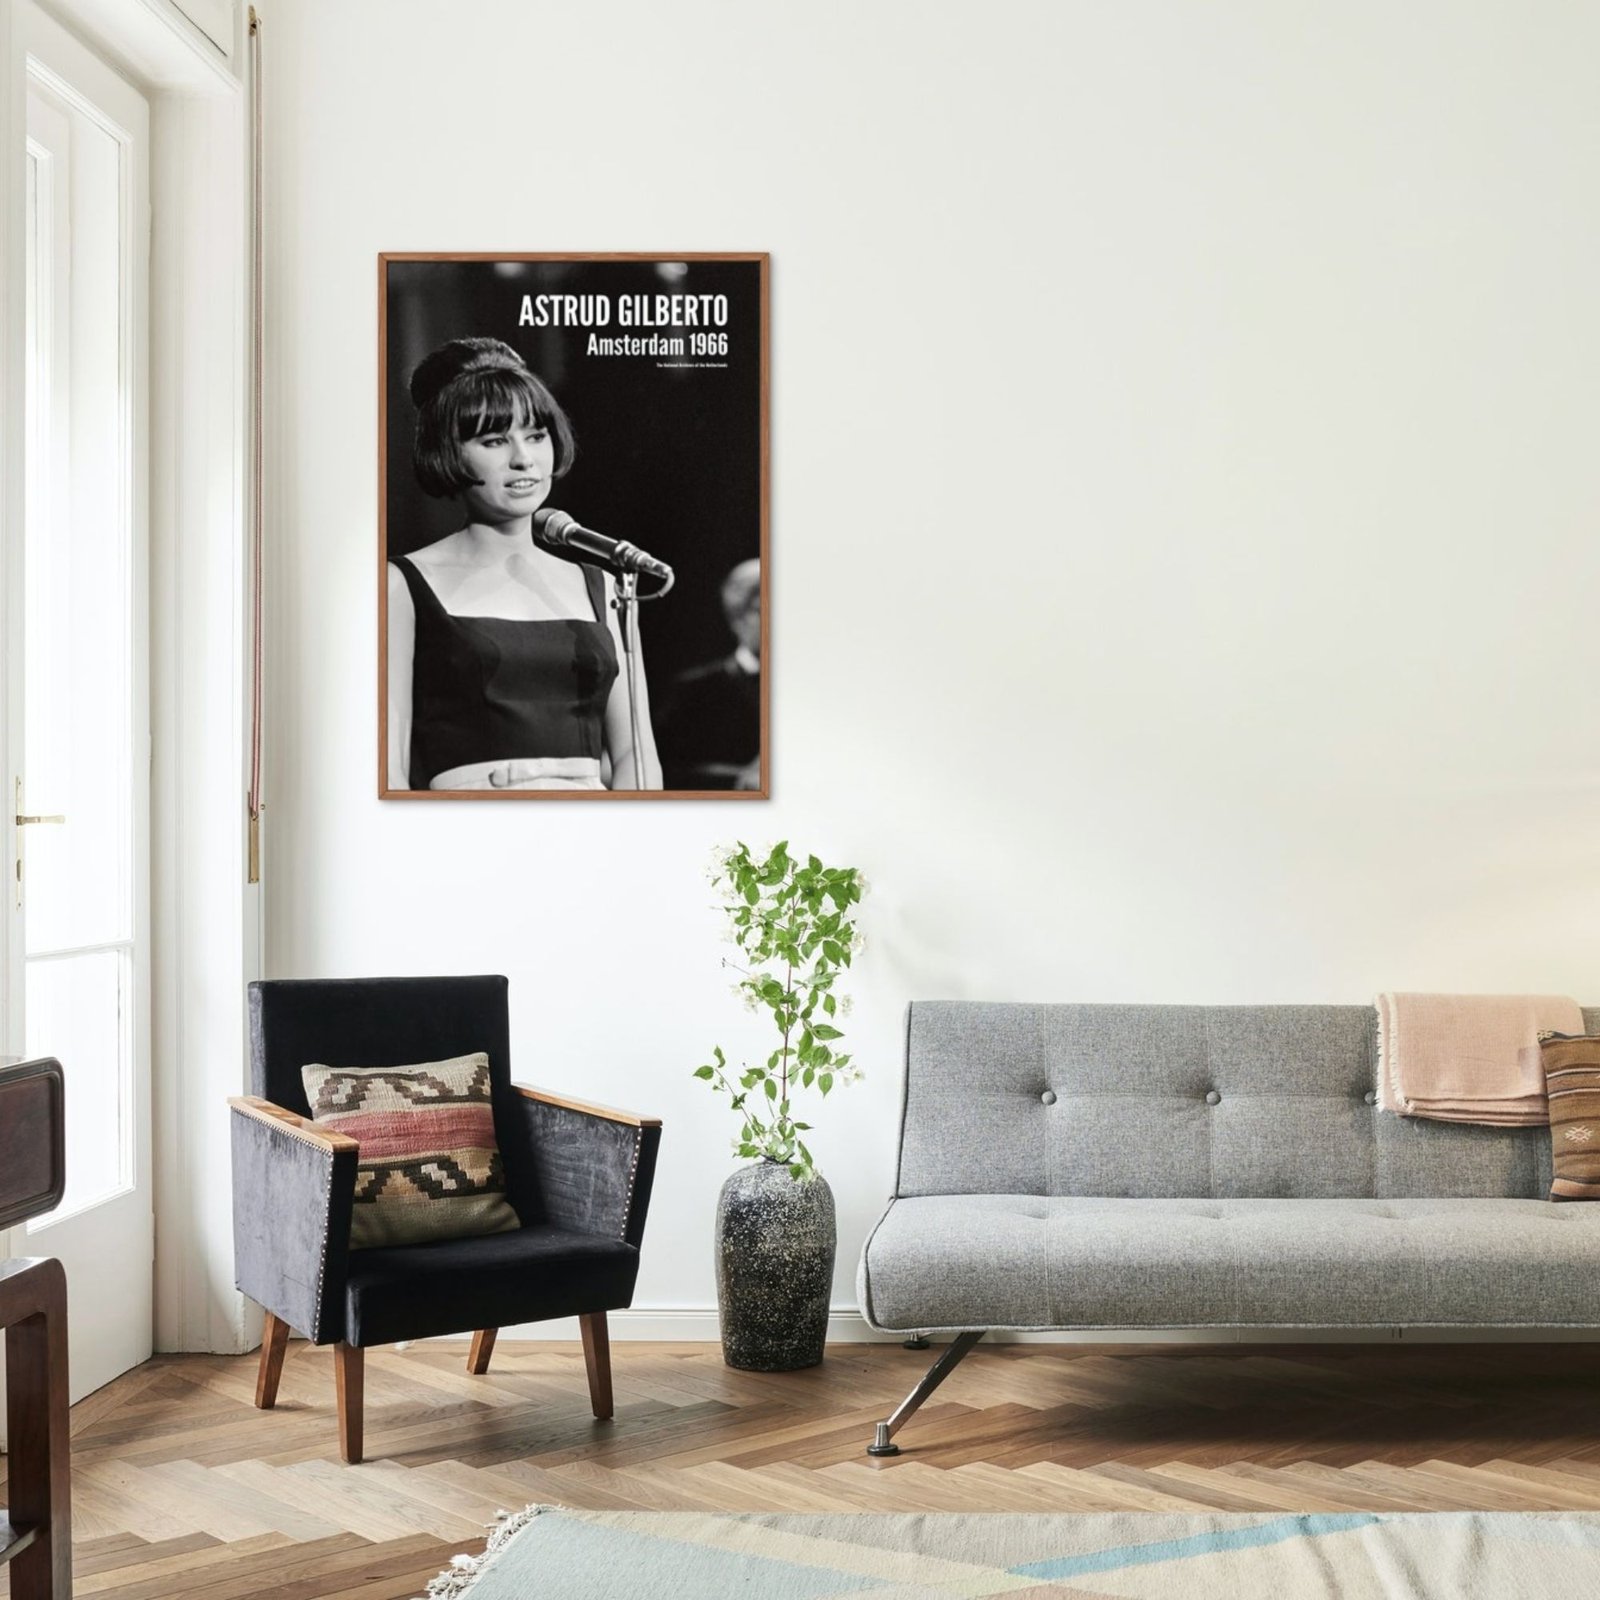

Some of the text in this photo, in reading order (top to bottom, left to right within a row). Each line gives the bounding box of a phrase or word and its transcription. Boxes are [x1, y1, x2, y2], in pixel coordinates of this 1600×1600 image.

[518, 294, 728, 327] ASTRUD GILBERTO
[587, 332, 729, 356] Amsterdam 1966
